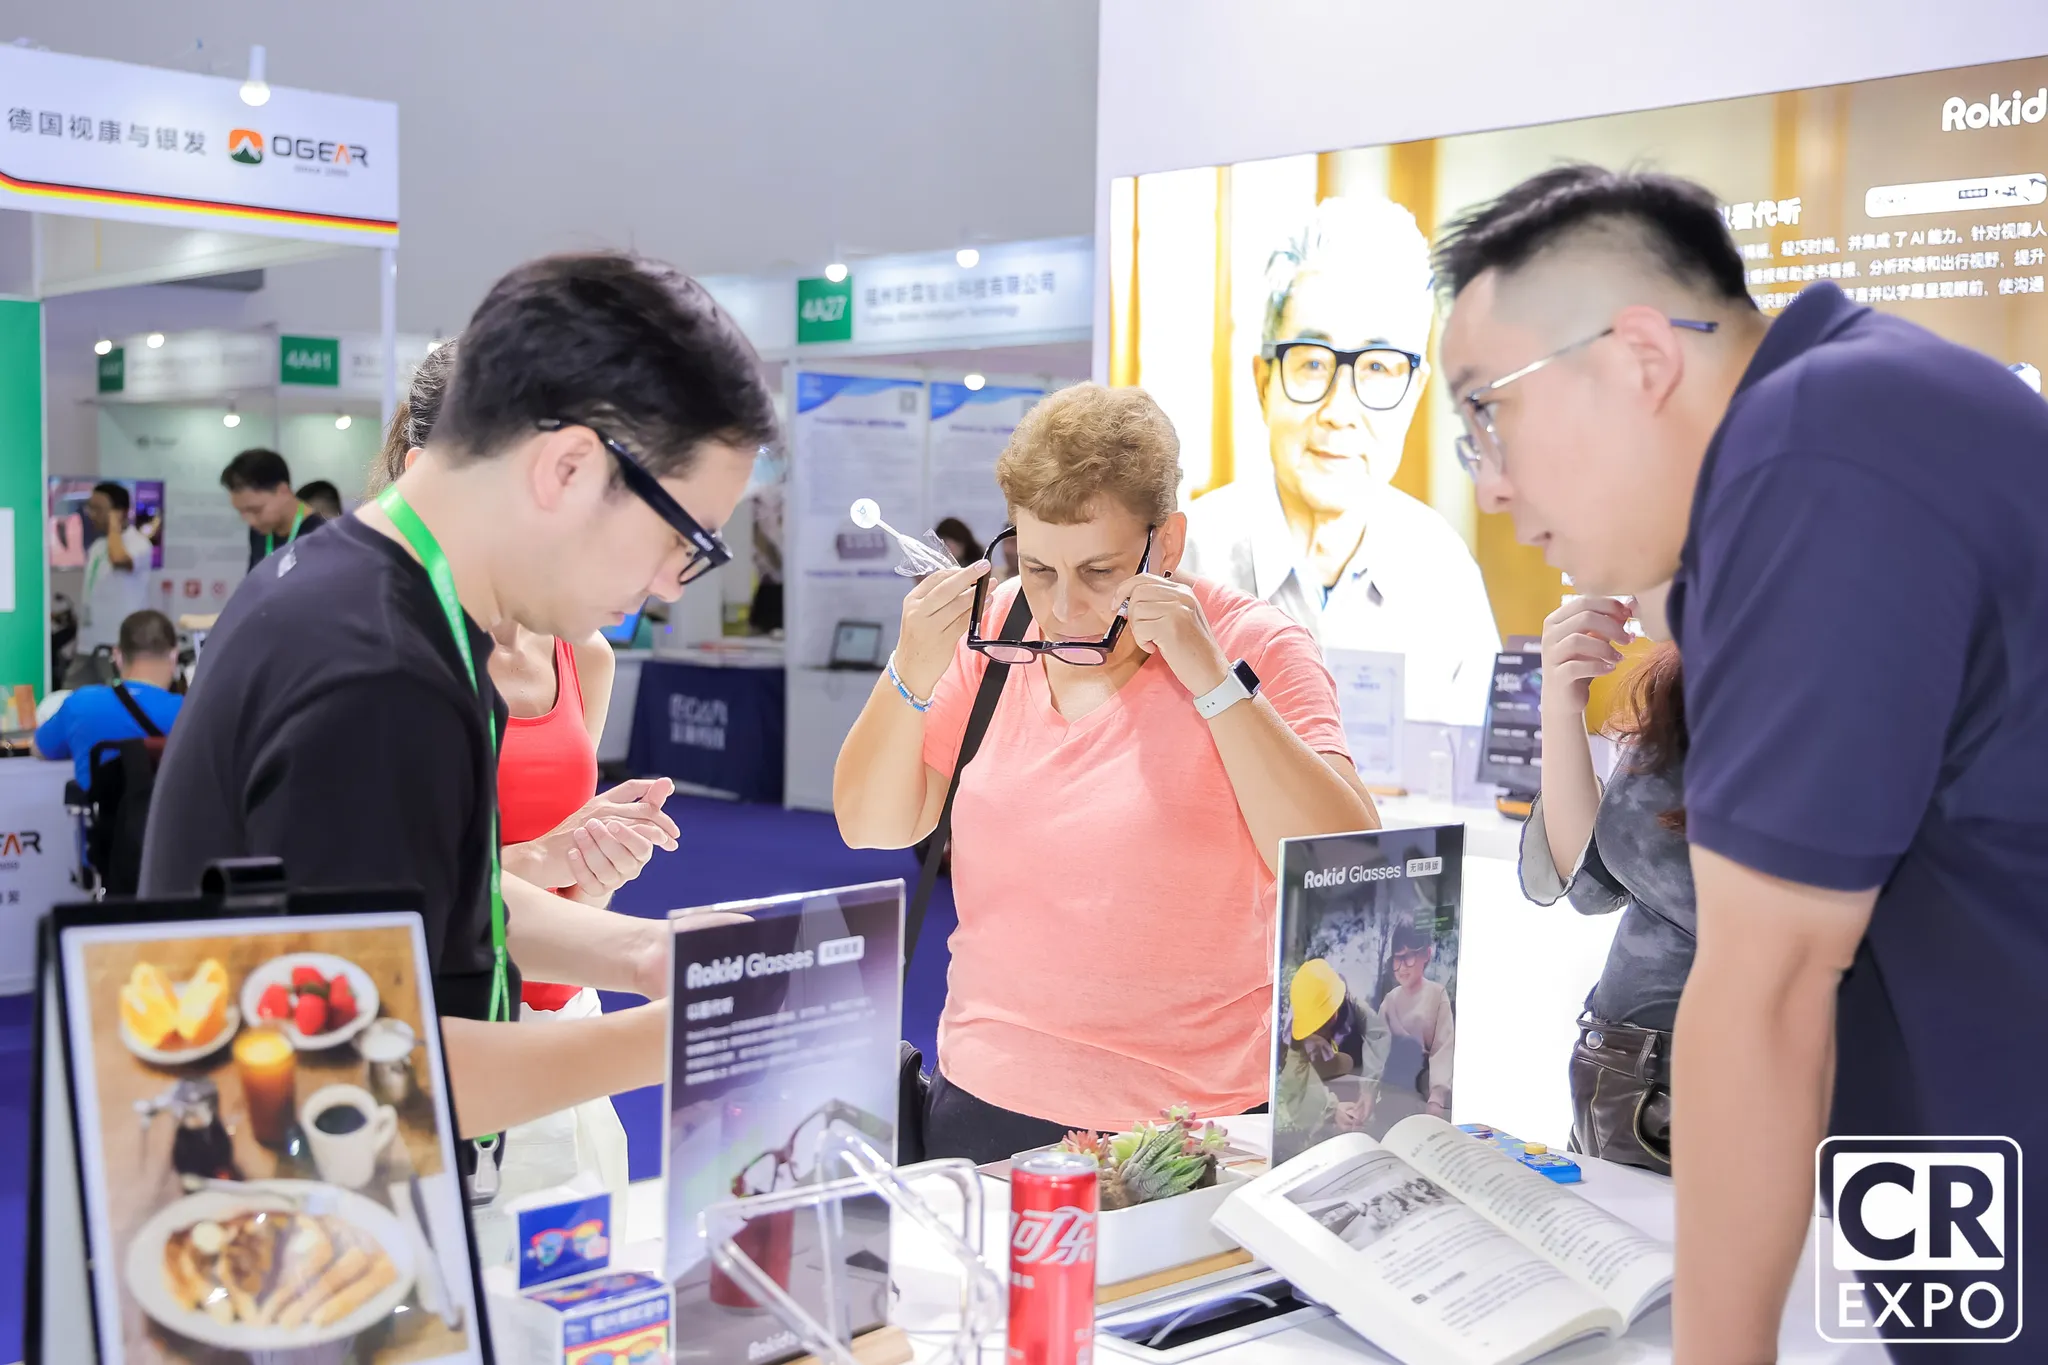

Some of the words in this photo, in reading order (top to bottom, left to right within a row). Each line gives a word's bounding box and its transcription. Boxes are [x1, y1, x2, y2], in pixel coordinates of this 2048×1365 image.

[1941, 87, 2048, 132] Rokid
[7, 106, 207, 156] 德国视康与银发
[272, 136, 369, 168] OGEAR
[0, 831, 42, 856] AR
[1303, 866, 1347, 889] Rokid
[1348, 865, 1402, 883] Glasses
[686, 954, 745, 990] Rokid
[745, 949, 815, 979] Glasses
[1010, 1205, 1097, 1266] 可乐
